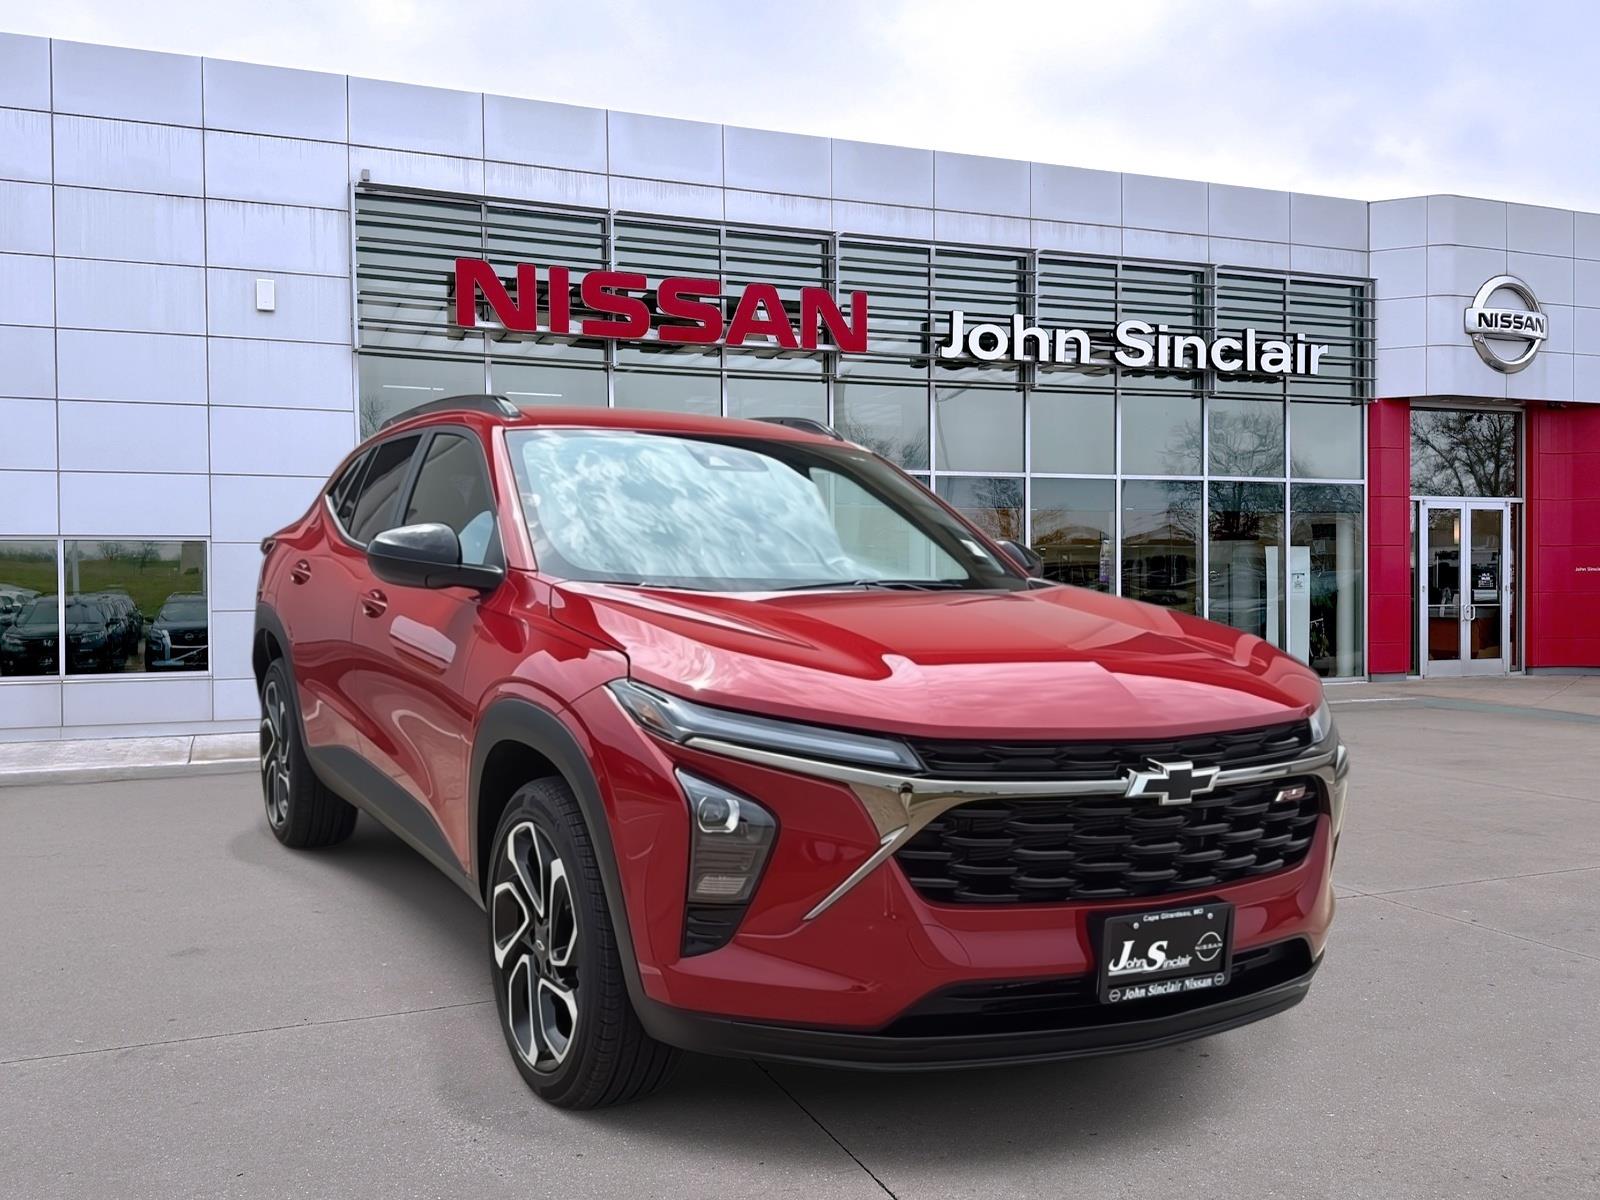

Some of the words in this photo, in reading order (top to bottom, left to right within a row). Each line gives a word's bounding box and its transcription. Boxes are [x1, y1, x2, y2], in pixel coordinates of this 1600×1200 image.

[455, 257, 868, 352] NISSAN
[1478, 312, 1544, 333] NISSAN
[940, 310, 1091, 364] John
[1114, 319, 1329, 375] Sinclair
[1108, 940, 1147, 972] John
[1146, 940, 1192, 971] Sinclair
[1195, 942, 1223, 950] NISSAN
[1122, 988, 1146, 1001] John
[1147, 980, 1183, 996] Sinclair
[1183, 977, 1212, 991] Nissan
